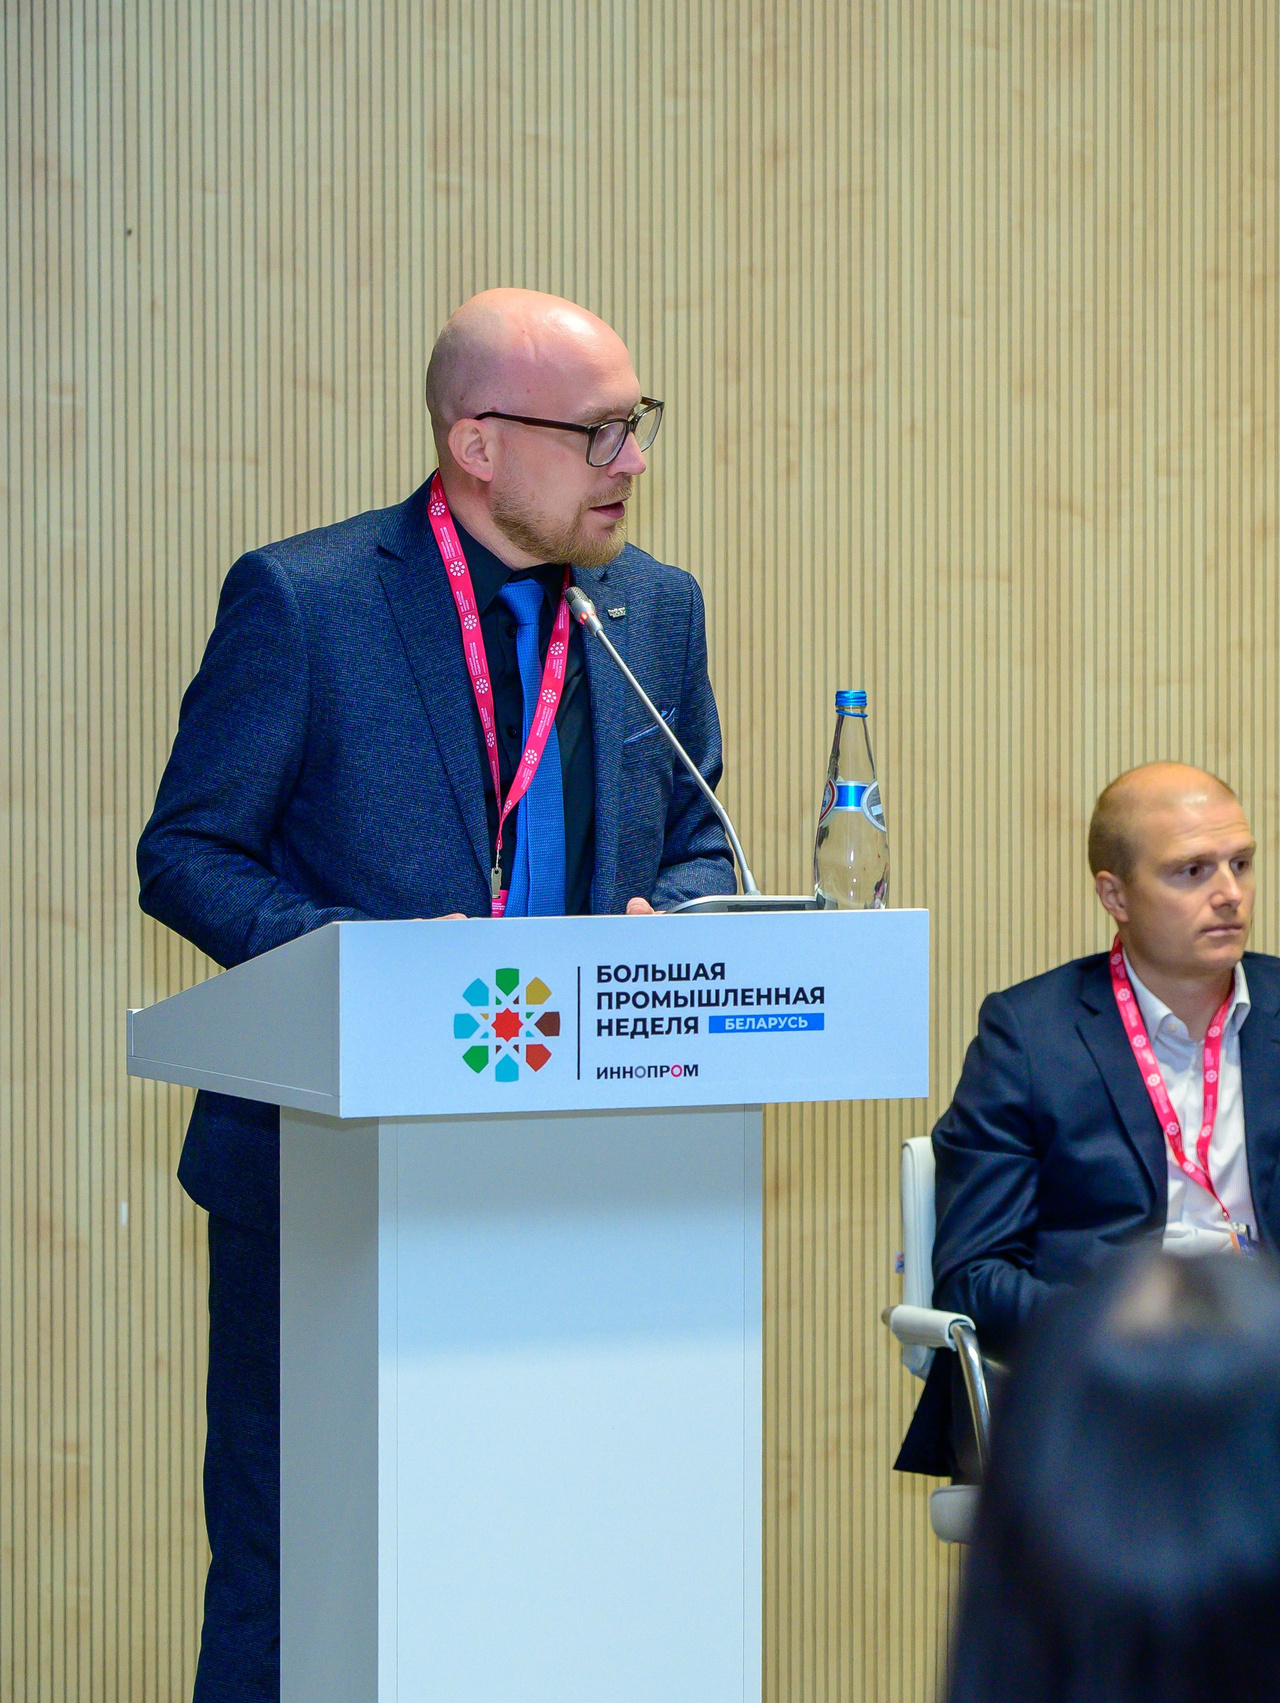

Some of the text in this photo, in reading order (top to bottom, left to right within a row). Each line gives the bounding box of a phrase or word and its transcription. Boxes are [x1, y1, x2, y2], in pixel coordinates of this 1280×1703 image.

[596, 962, 726, 983] БОЛЬШАЯ
[596, 986, 825, 1010] ПРОМЫШЛЕННАЯ
[596, 1016, 809, 1039] НЕДЕЛЯ БЕЛАРУСЬ
[596, 1064, 699, 1080] ИННОПРОМ
